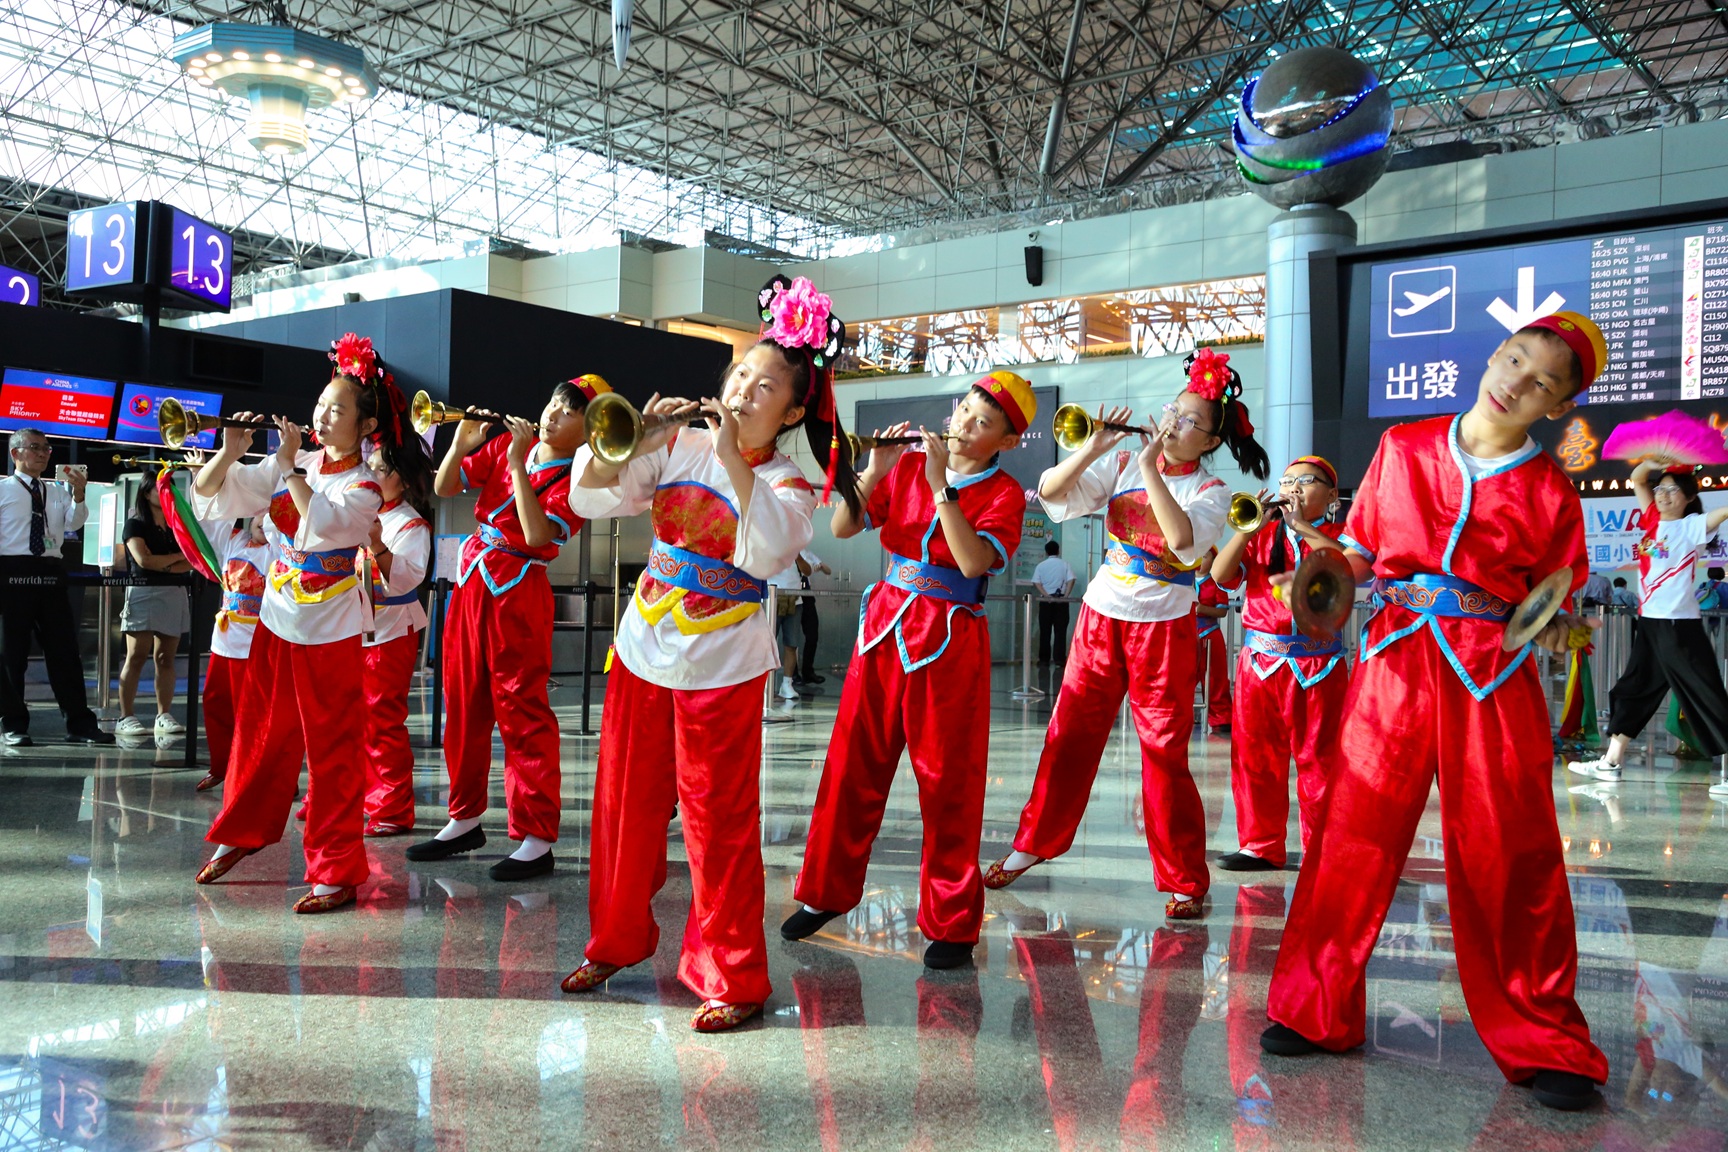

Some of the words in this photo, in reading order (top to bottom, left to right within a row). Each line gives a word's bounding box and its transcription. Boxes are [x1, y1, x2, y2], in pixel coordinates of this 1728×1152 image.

[1614, 237, 1635, 245] 目的地
[76, 214, 125, 278] 13
[1592, 249, 1611, 258] 16:25
[182, 225, 224, 296] 13
[1592, 259, 1611, 268] 16:30
[1592, 270, 1611, 278] 16:40
[1591, 280, 1610, 289] 16:40
[1591, 291, 1610, 299] 16:40
[1591, 301, 1610, 309] 16:55
[1590, 312, 1609, 320] 17:05
[1704, 300, 1727, 309] CI122
[1633, 318, 1655, 326] 名古屋
[1704, 312, 1727, 321] CI150
[1386, 360, 1460, 401] 出發
[1594, 374, 1608, 382] :10
[1589, 384, 1608, 392] 18:10
[1588, 394, 1608, 403] 18:35
[1578, 479, 1634, 491] IWAN
[9, 576, 42, 585] everrich
[103, 576, 133, 585] everrich
